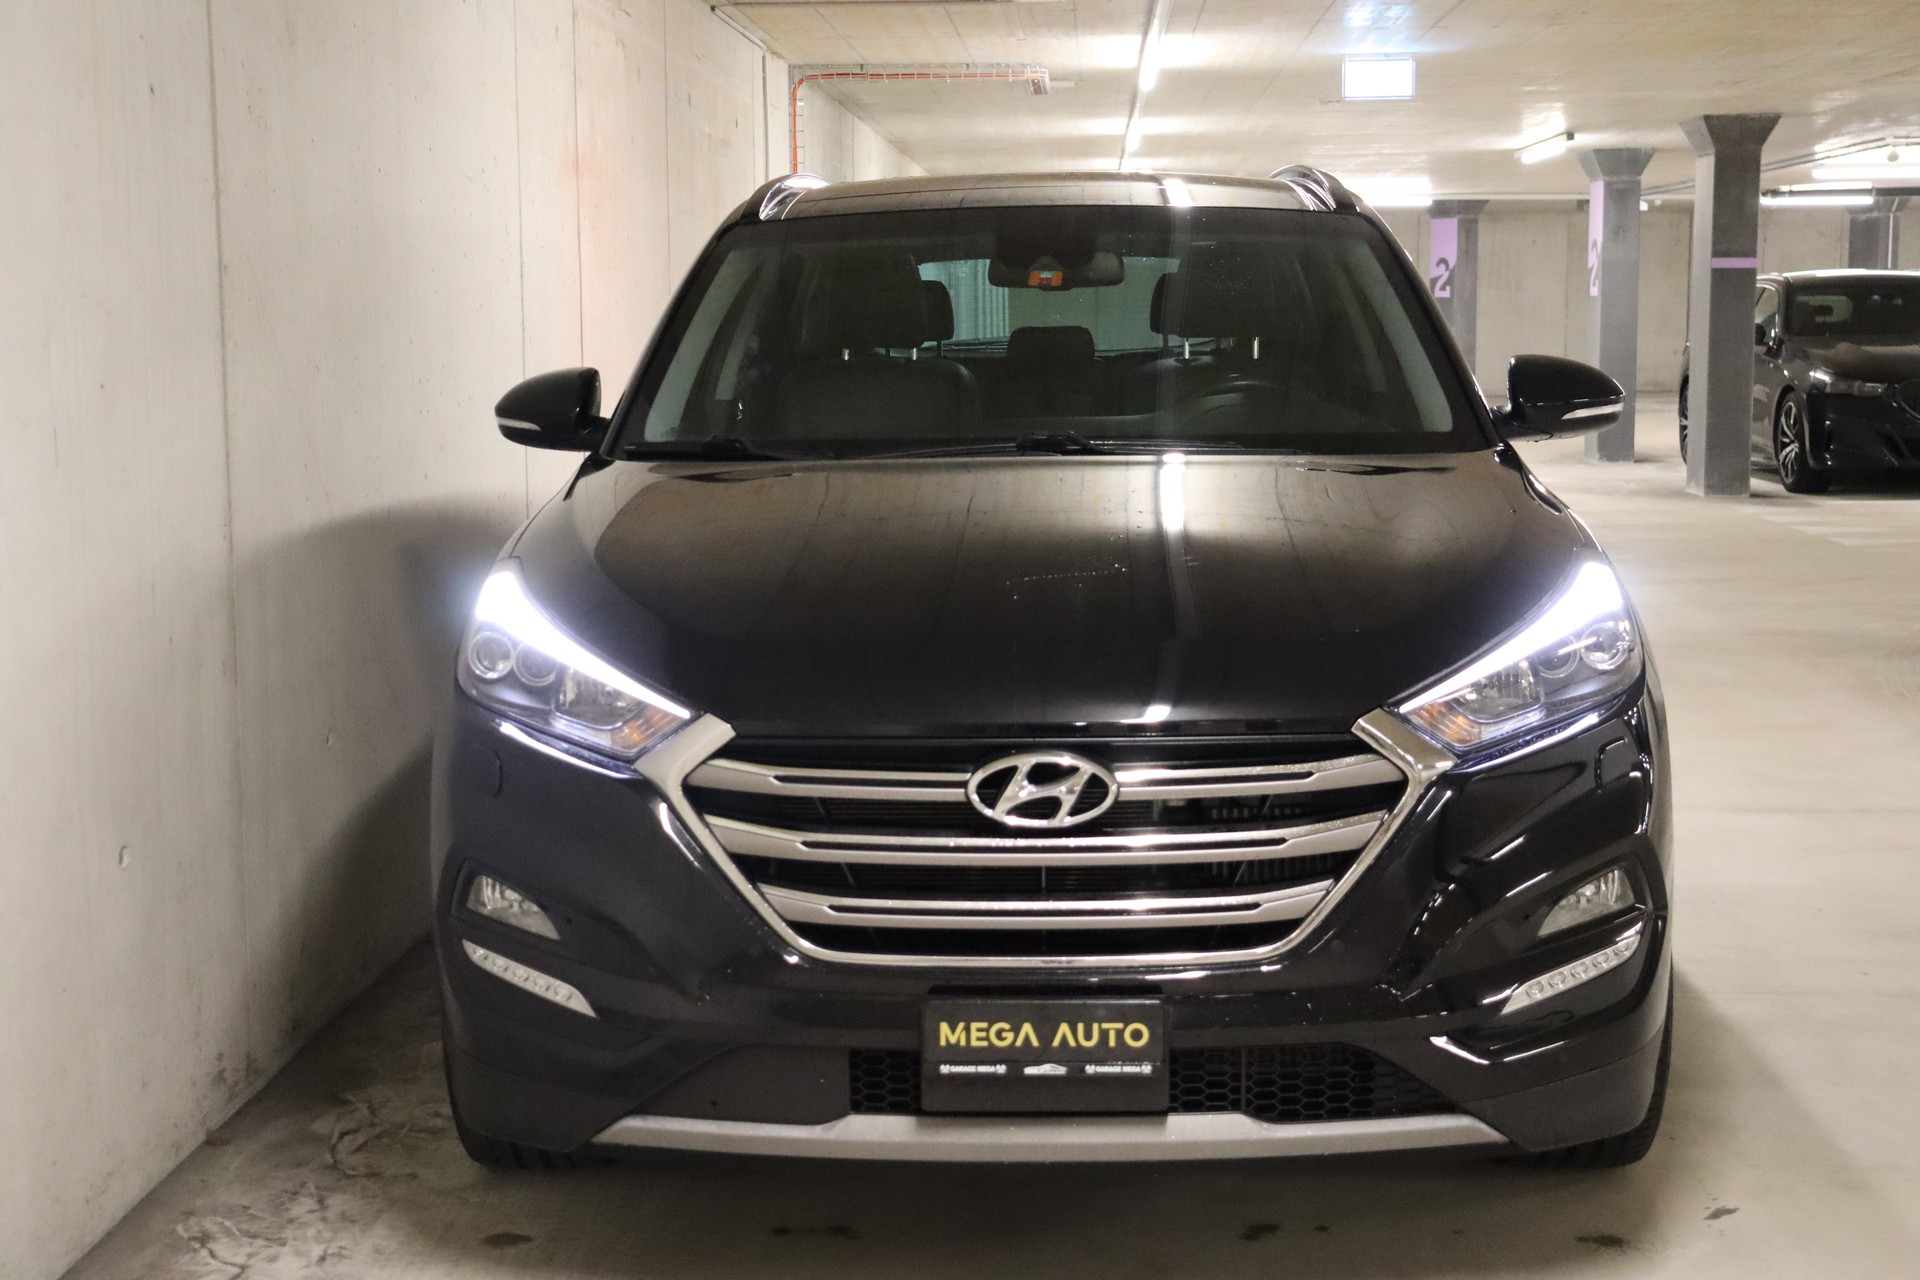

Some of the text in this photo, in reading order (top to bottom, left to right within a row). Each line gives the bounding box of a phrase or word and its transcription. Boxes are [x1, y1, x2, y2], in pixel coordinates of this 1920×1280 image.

[1434, 257, 1450, 298] 2
[939, 1021, 1150, 1047] MEGA AUTO
